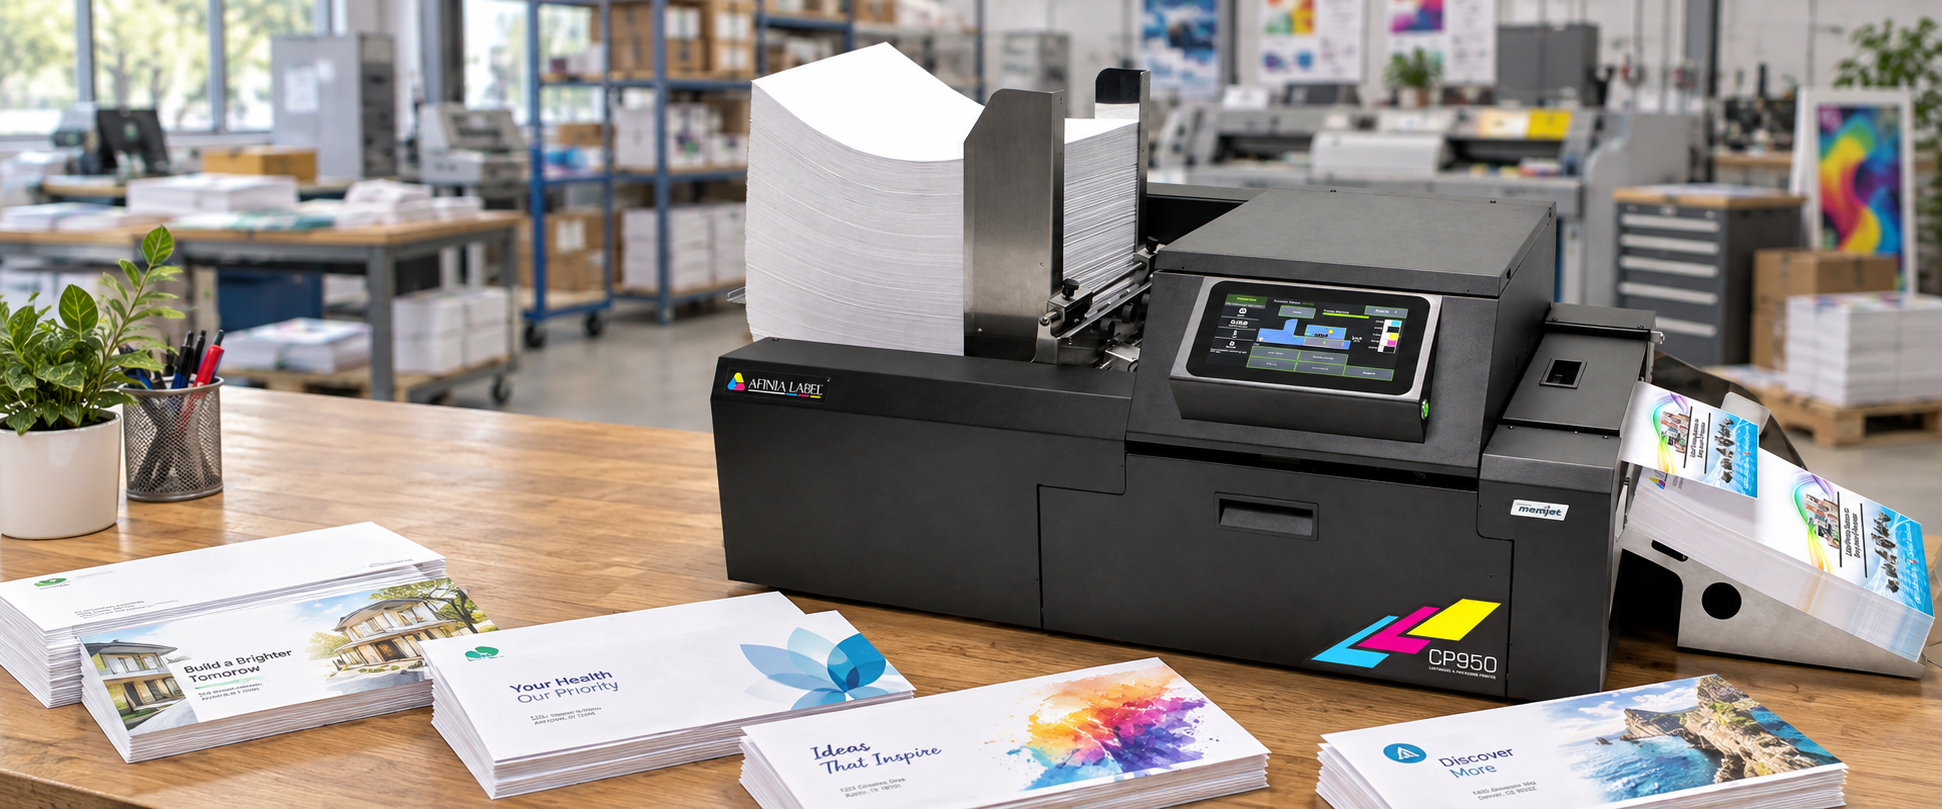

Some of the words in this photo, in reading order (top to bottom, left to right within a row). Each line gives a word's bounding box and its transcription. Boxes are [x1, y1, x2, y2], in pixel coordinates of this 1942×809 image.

[748, 378, 786, 392] AFINIA
[788, 382, 823, 396] LABEL
[1518, 505, 1562, 517] memjet
[183, 661, 222, 674] Build
[223, 660, 234, 668] a
[235, 649, 293, 664] Brighter
[1428, 648, 1498, 673] CP950
[188, 665, 261, 683] Tomorow
[509, 681, 552, 693] Your
[554, 671, 613, 686] Health
[517, 692, 550, 704] Our
[554, 682, 619, 698] Priority
[810, 743, 871, 760] Ideas
[819, 757, 869, 775] That
[872, 747, 943, 765] Inspire
[1438, 748, 1514, 768] Discover
[1449, 764, 1498, 779] More
